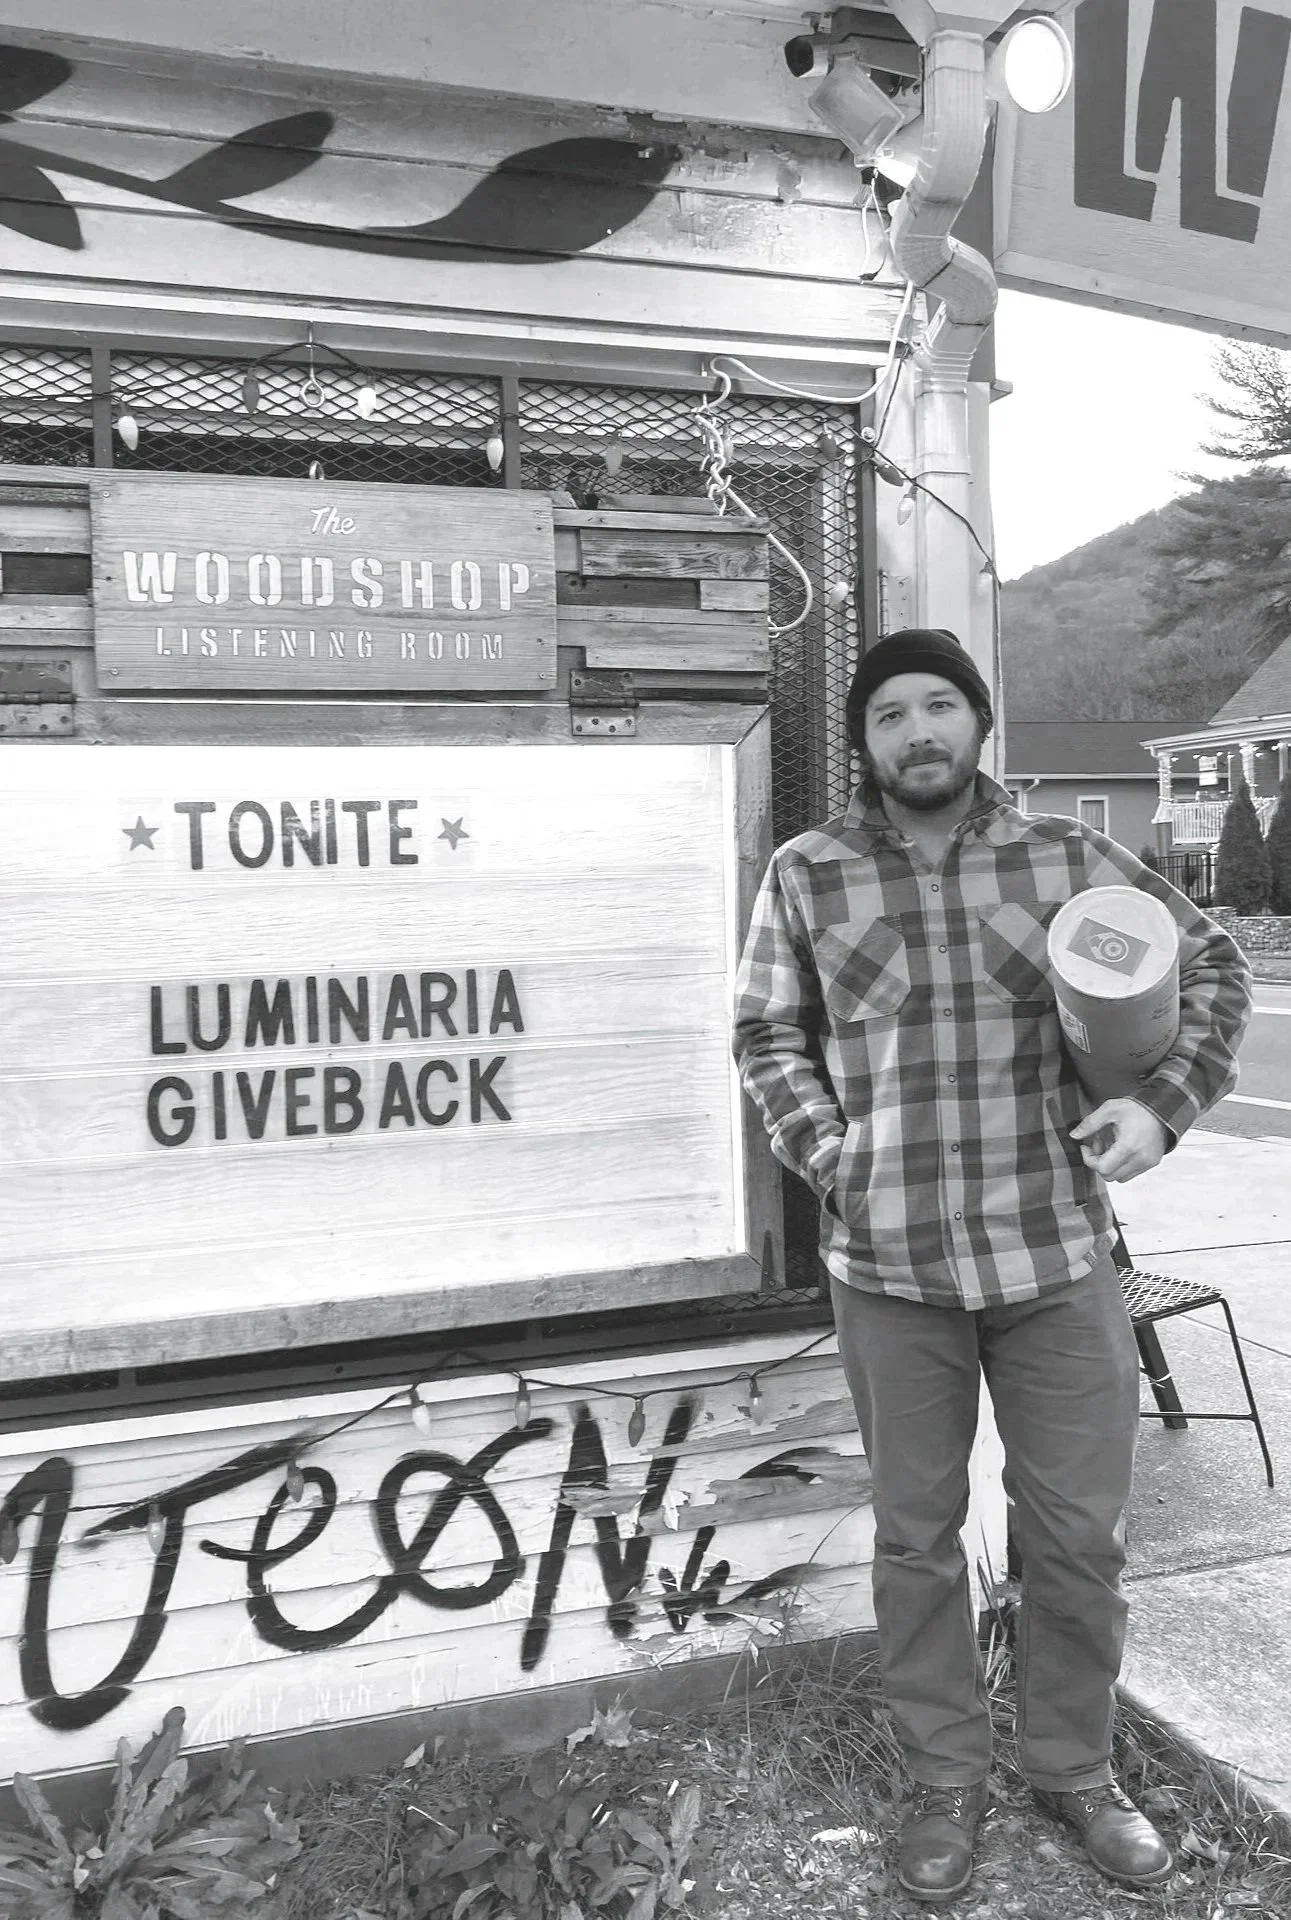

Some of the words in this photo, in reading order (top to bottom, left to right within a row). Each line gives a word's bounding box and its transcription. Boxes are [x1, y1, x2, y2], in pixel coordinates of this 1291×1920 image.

[310, 506, 357, 535] The
[122, 550, 531, 611] WOODSHOP
[156, 627, 374, 659] LISTENING
[400, 631, 504, 660] ROOM
[173, 799, 419, 871] TONITE
[150, 968, 524, 1055] LUMINARIA
[147, 1056, 512, 1148] GIVEBACK
